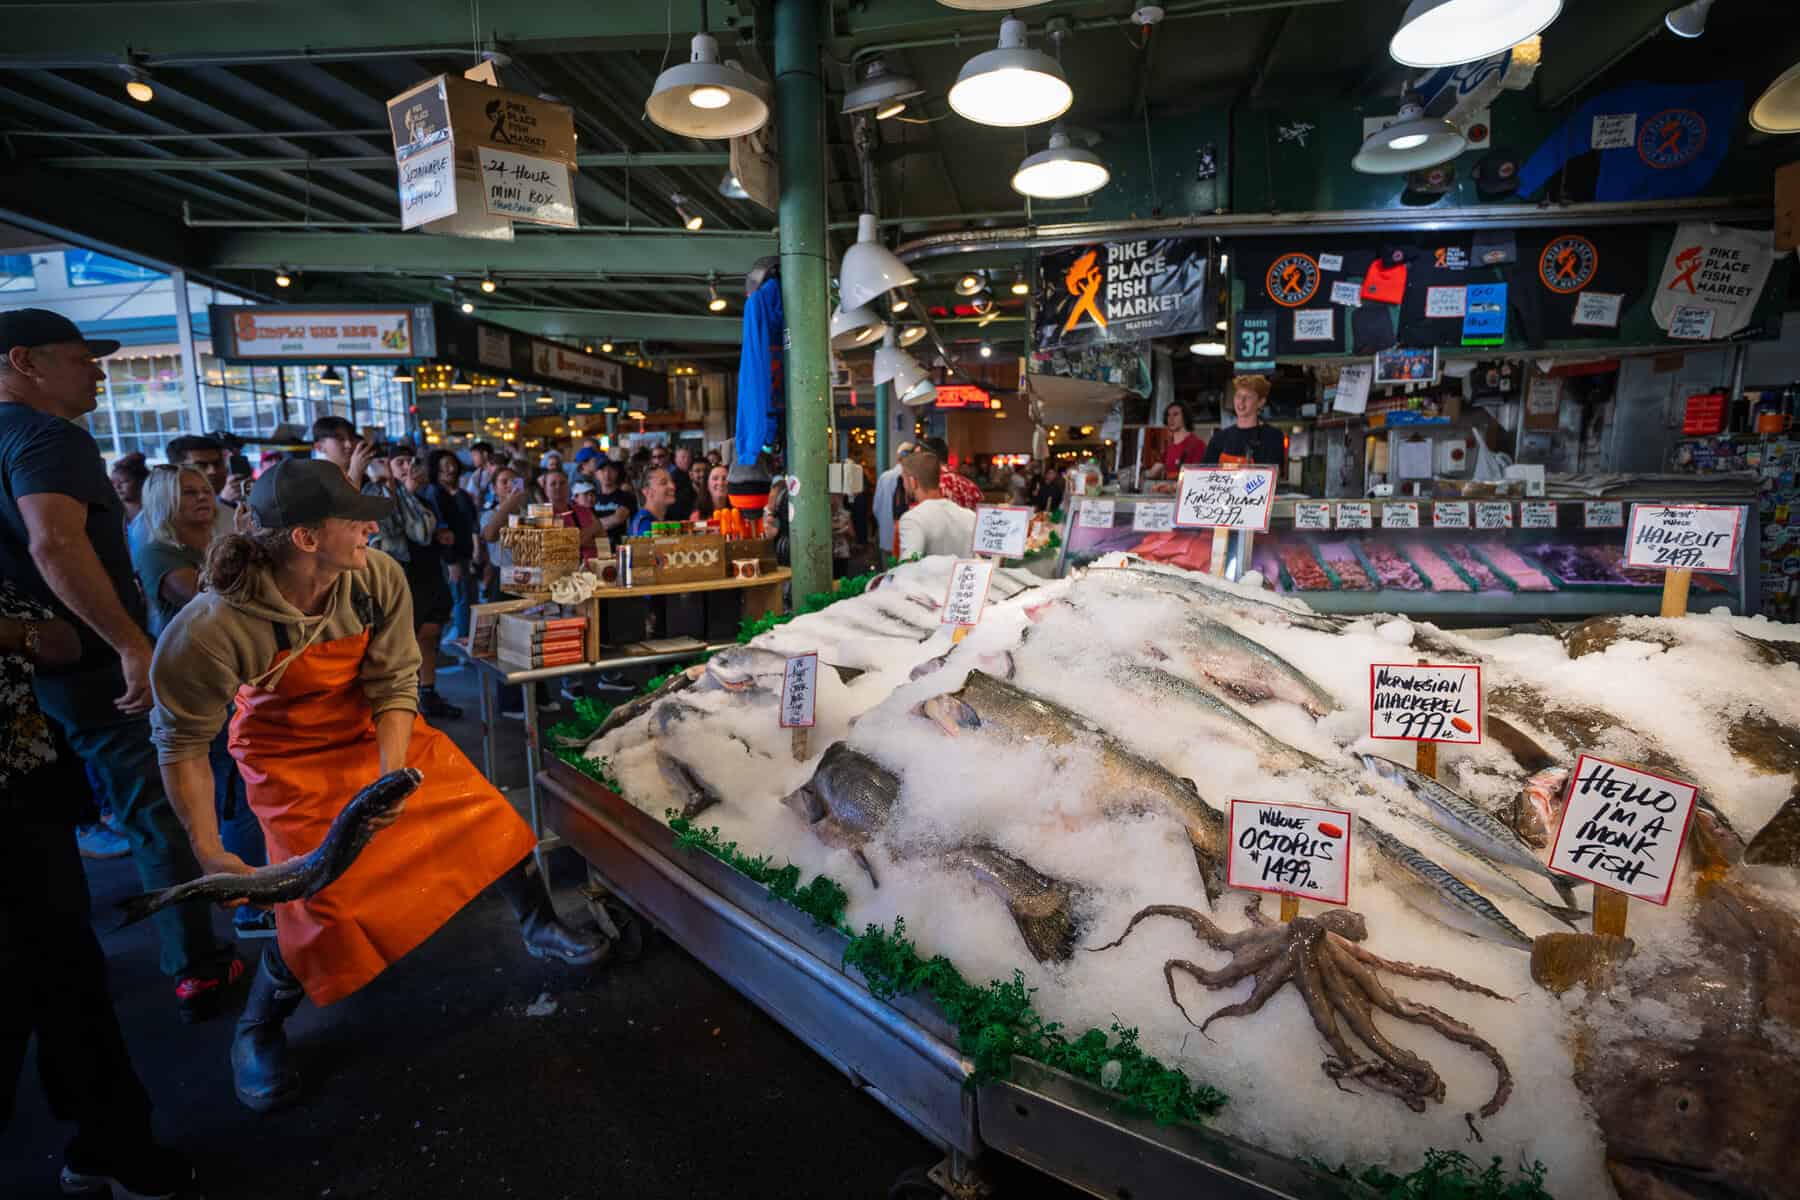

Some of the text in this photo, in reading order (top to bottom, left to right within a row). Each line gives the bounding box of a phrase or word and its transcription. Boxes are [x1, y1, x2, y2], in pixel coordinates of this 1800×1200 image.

[487, 159, 558, 188] 24 HOUR
[491, 185, 554, 206] MINI BOX
[1108, 240, 1148, 264] PIKE
[1709, 247, 1742, 260] PIKE
[1107, 256, 1166, 282] PLACE
[1701, 270, 1732, 283] FISH
[1705, 258, 1752, 273] PLACE
[1107, 279, 1147, 300] FISH
[1697, 282, 1753, 297] MARKET
[1107, 293, 1184, 319] MARKET
[1241, 331, 1270, 357] 32
[1184, 487, 1216, 505] KING
[1636, 524, 1730, 548] HALIBUT
[1376, 666, 1466, 693] NORWEGIAN
[1374, 691, 1471, 714] MACKEREL
[1577, 764, 1677, 814] HELLO
[1259, 807, 1312, 830] WHOLE
[1593, 801, 1673, 839] I'M A
[1239, 826, 1334, 861] OCTOPUS
[1575, 820, 1657, 862] MONK
[1567, 844, 1660, 885] FISH
